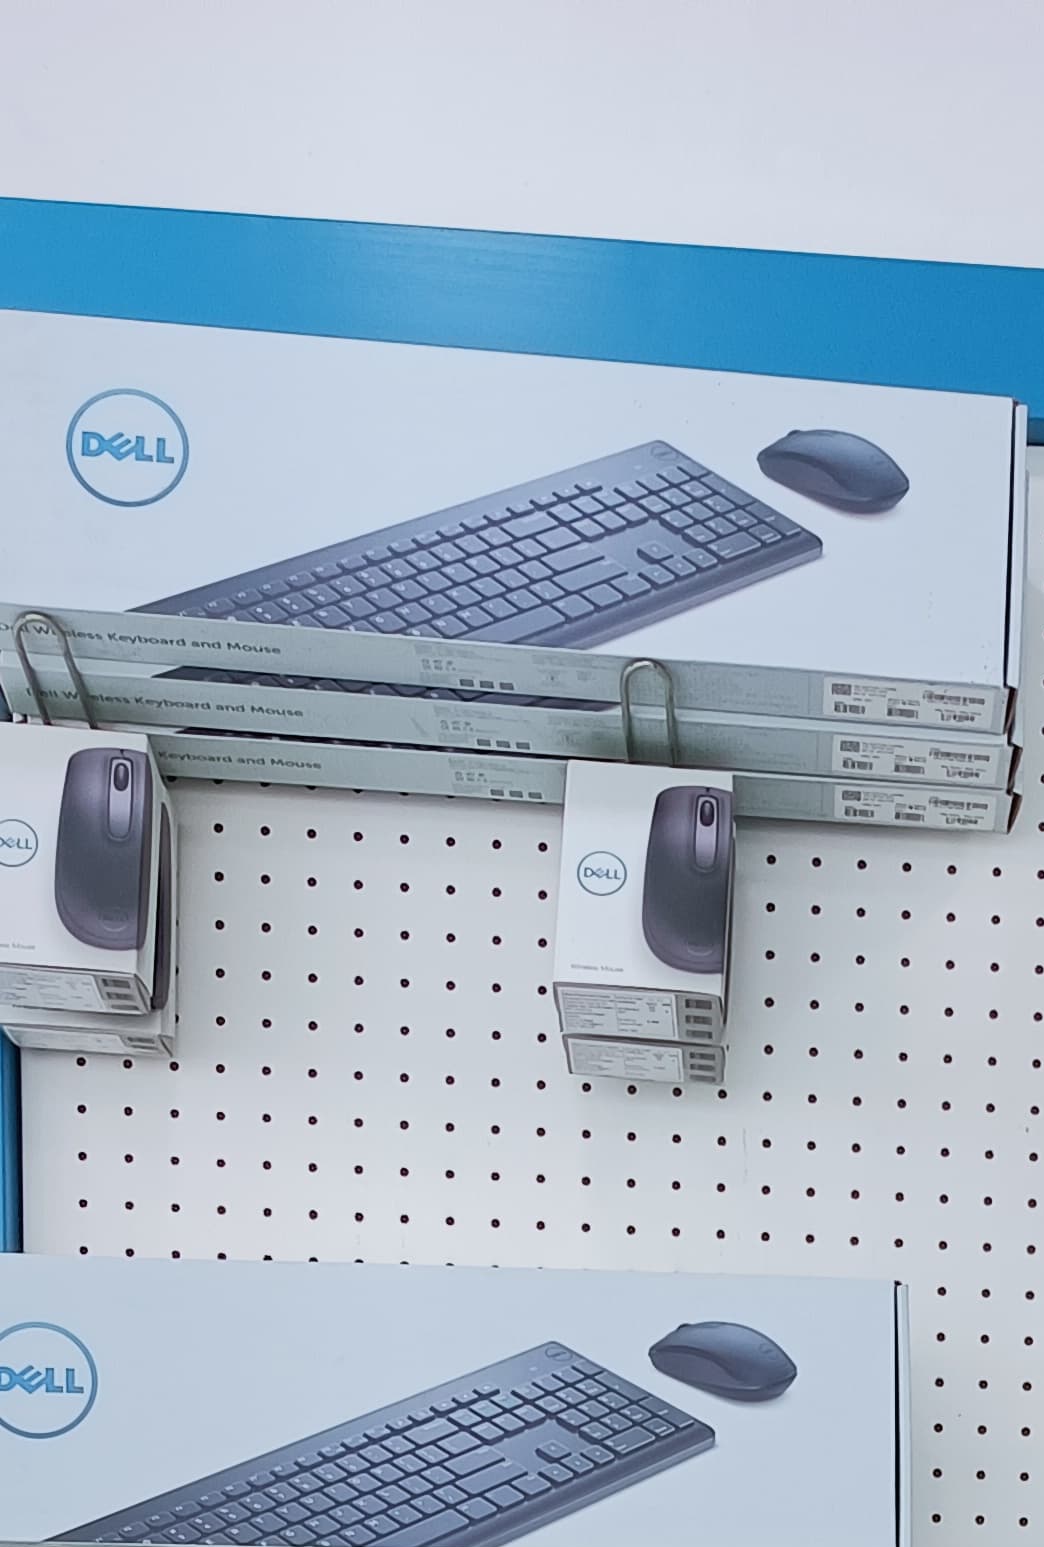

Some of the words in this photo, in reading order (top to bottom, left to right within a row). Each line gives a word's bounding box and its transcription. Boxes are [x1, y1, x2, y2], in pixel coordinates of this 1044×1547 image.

[81, 431, 175, 465] DELL
[107, 632, 186, 648] Keyboard
[191, 638, 222, 650] and
[227, 642, 282, 655] Mouse
[134, 696, 212, 712] Keyboard
[216, 702, 246, 714] and
[251, 705, 304, 718] Mouse
[158, 751, 233, 766] Keyboard
[236, 755, 266, 766] and
[270, 758, 323, 770] Mouse
[584, 867, 622, 880] DELL
